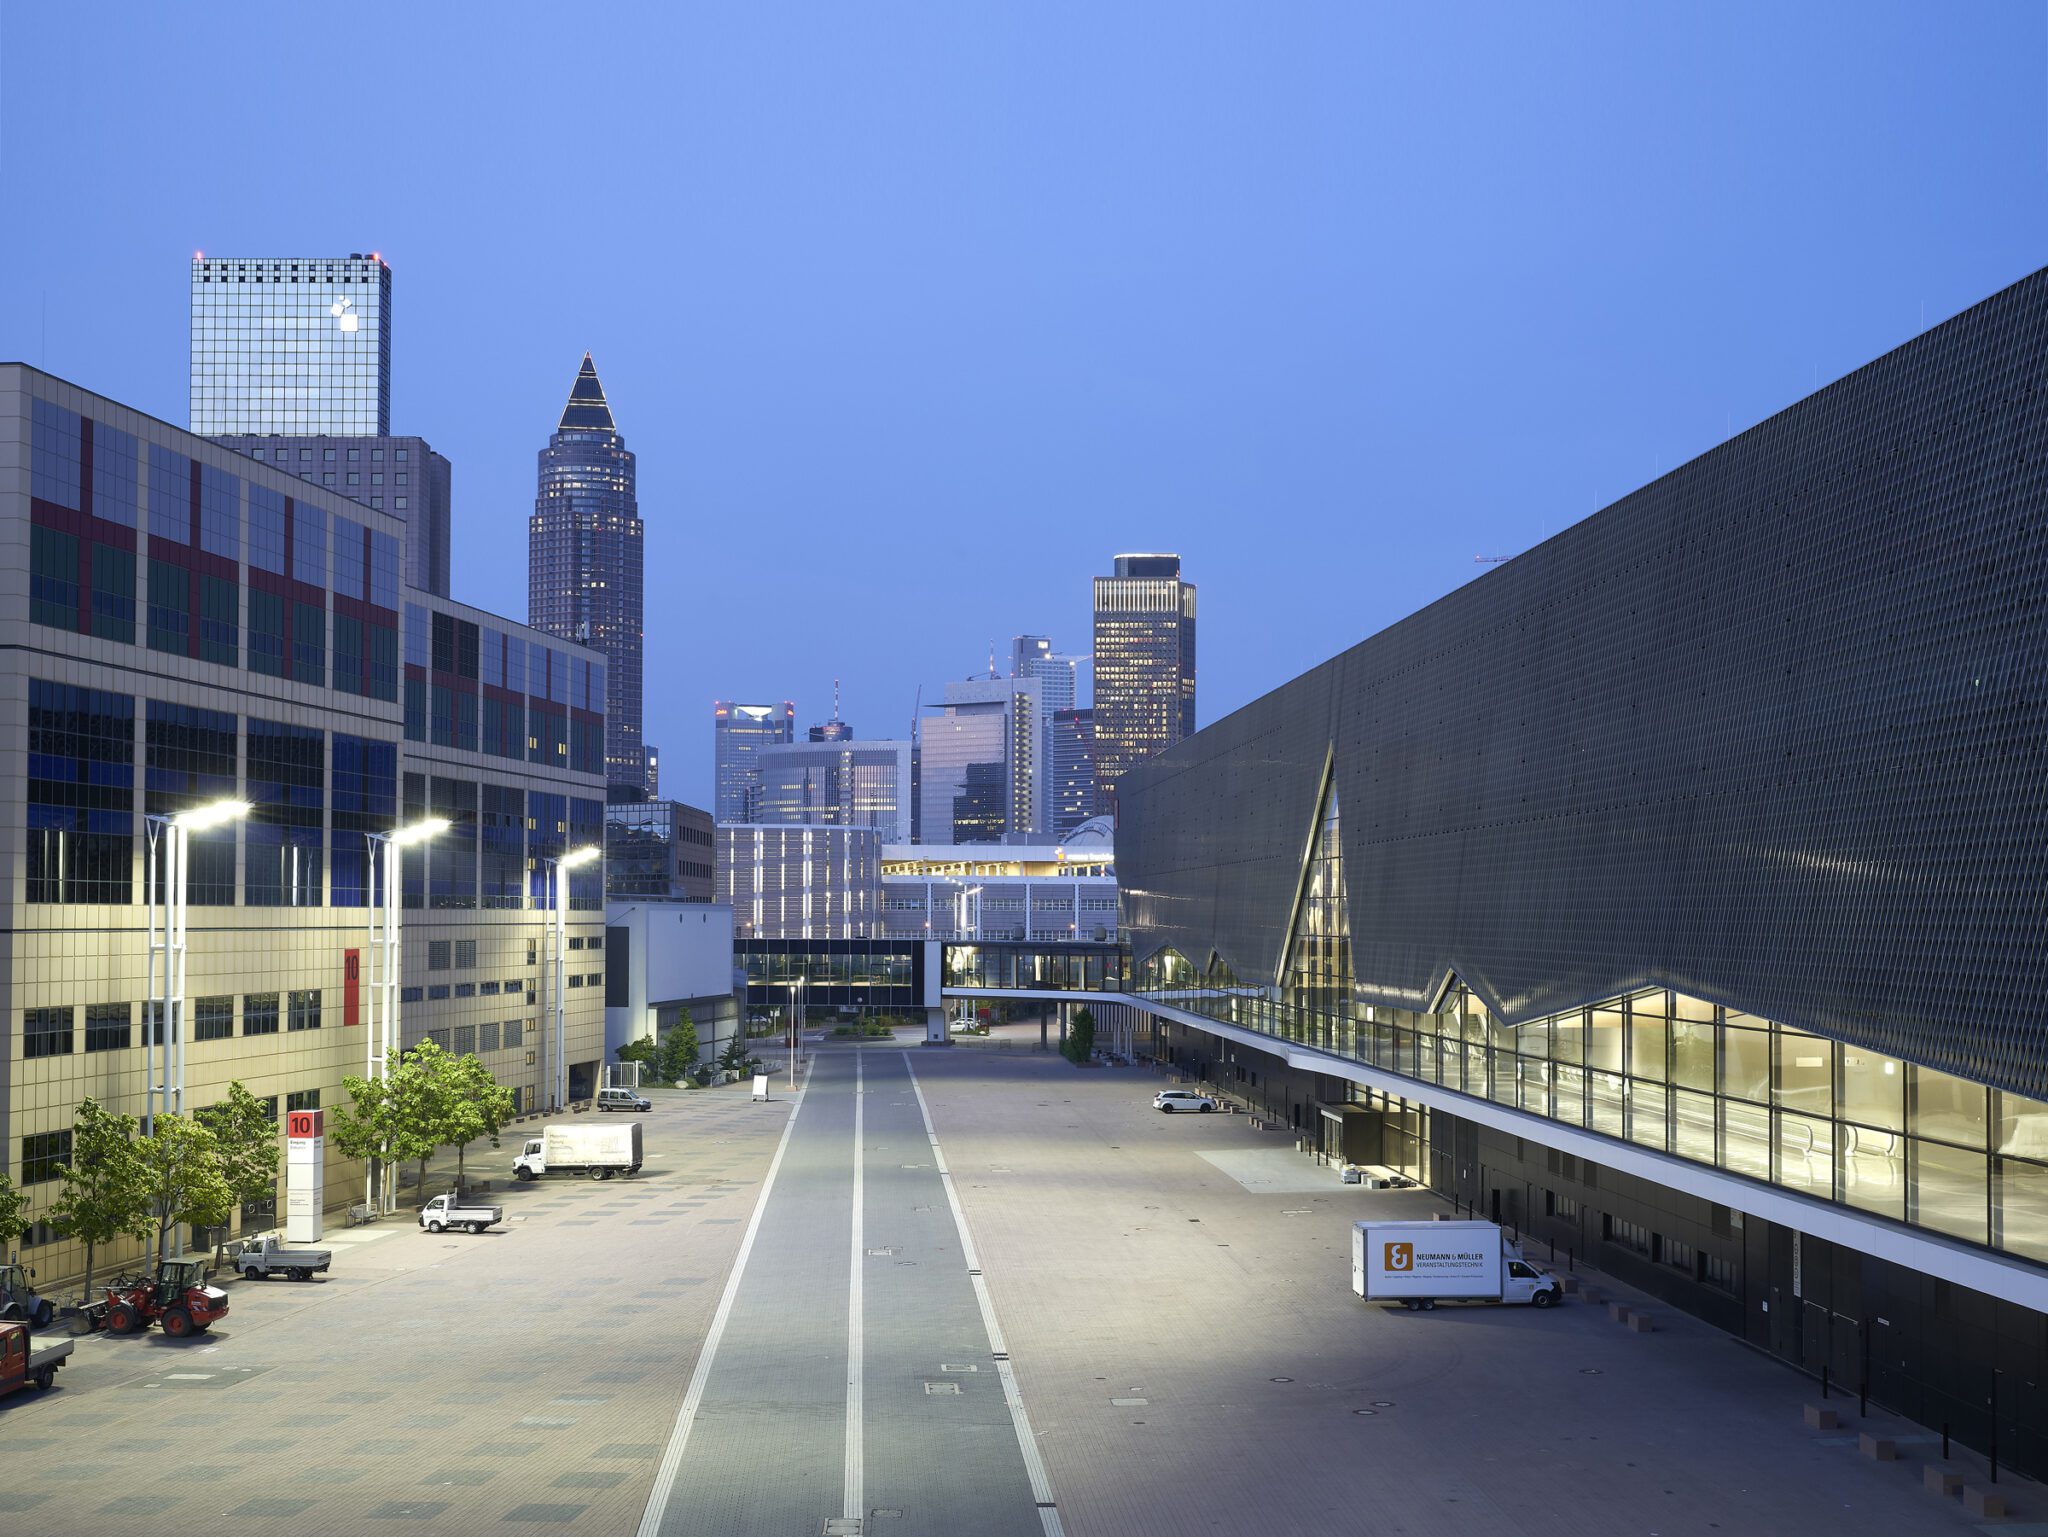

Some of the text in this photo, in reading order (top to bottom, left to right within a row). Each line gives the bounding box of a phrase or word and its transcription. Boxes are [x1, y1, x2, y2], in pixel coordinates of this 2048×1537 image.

[346, 955, 358, 980] 10
[291, 1117, 311, 1134] 10
[1416, 1253, 1450, 1261] NEUMANN
[1457, 1252, 1483, 1261] MÜLLER
